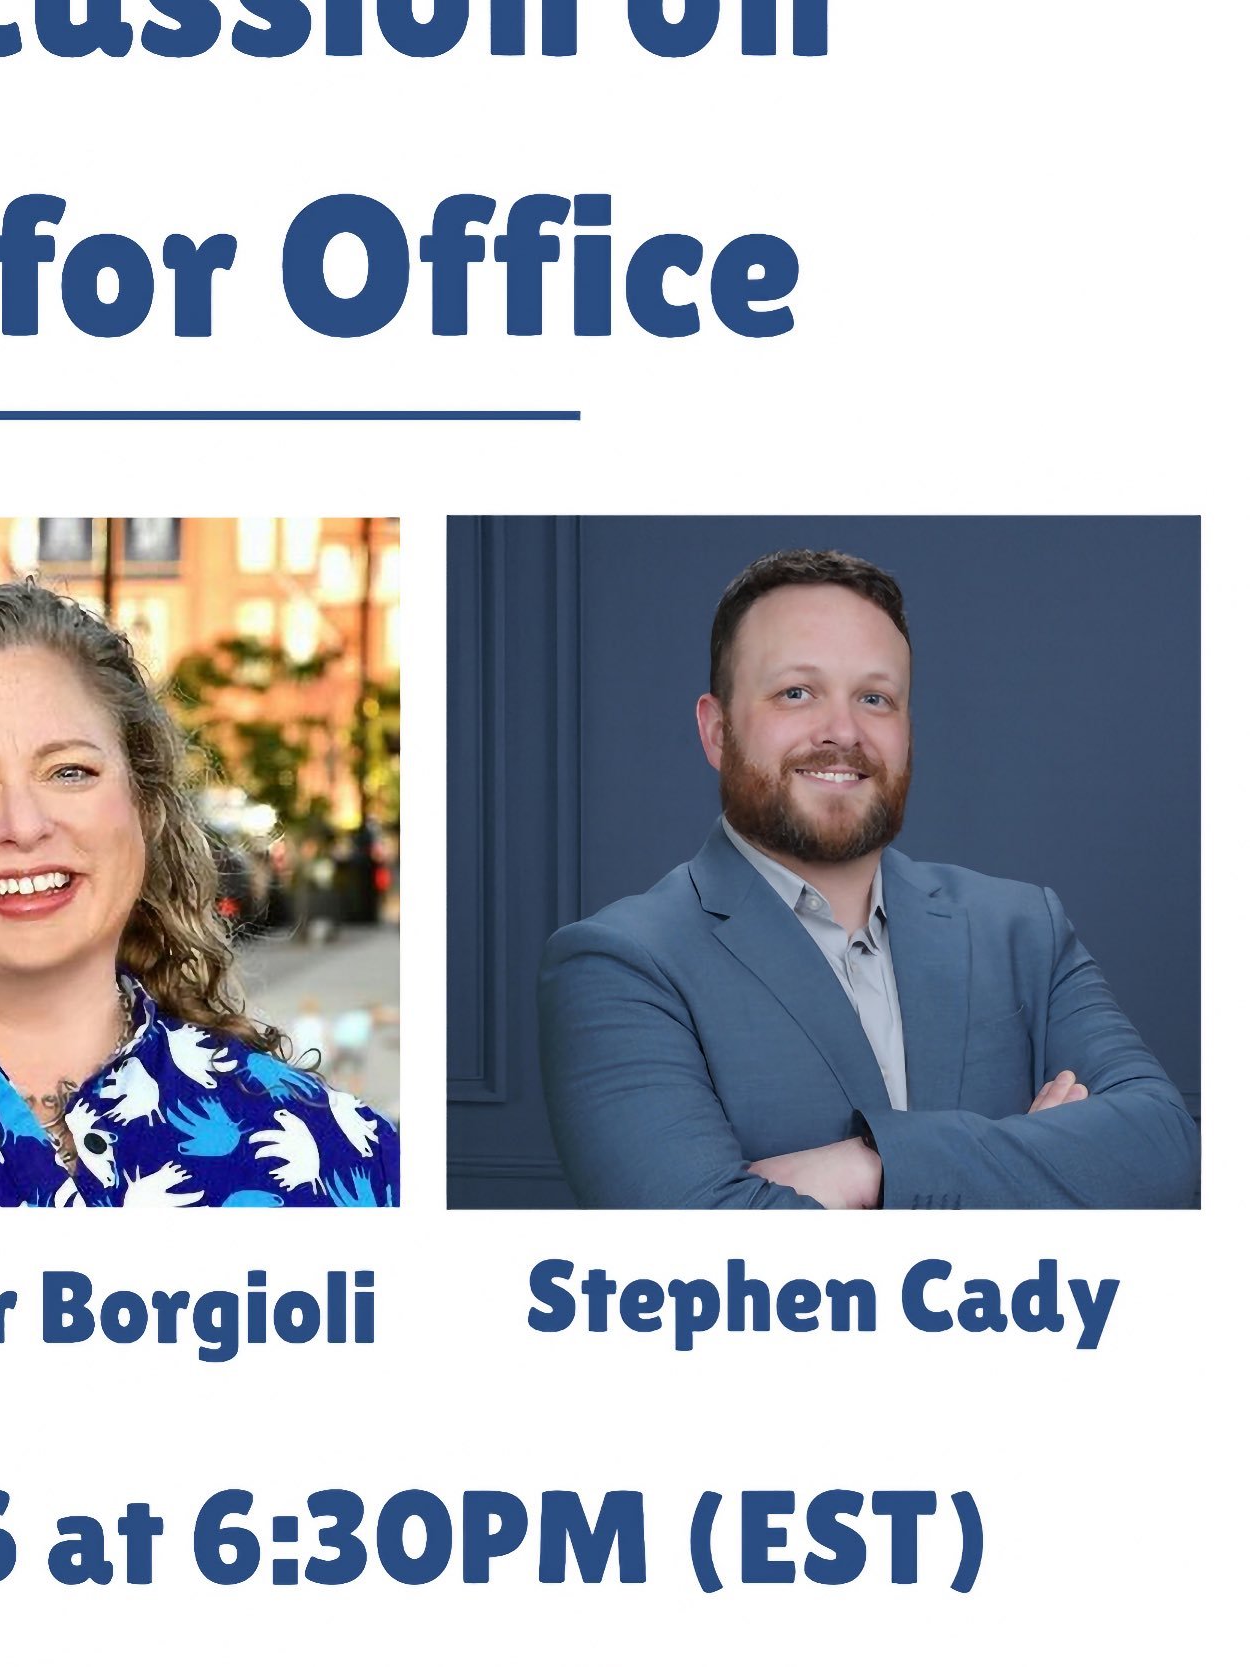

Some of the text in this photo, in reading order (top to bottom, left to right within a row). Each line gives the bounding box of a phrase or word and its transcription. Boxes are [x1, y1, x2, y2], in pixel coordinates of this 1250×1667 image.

[282, 194, 799, 338] Office
[43, 1270, 374, 1362] Borgioli
[528, 1259, 1120, 1351] Stephen Cady
[48, 1503, 163, 1585] at
[194, 1489, 646, 1585] 6:30PM
[690, 1489, 983, 1593] (EST)
